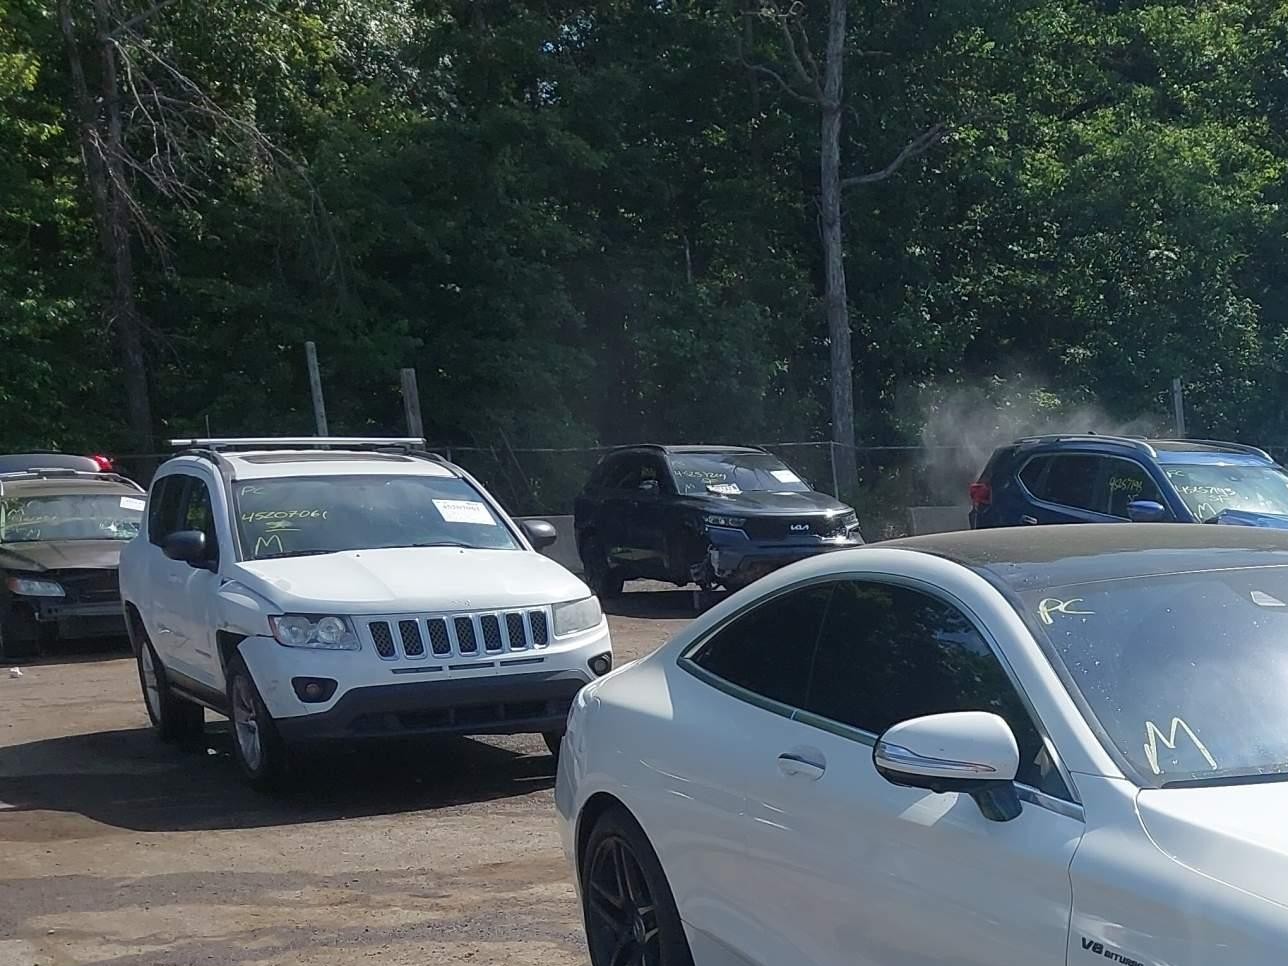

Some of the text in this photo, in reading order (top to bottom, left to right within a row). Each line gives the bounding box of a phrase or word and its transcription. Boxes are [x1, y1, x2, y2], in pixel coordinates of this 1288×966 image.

[255, 534, 284, 556] M
[1036, 597, 1097, 626] PC
[1143, 717, 1218, 776] M
[1081, 936, 1104, 955] V8
